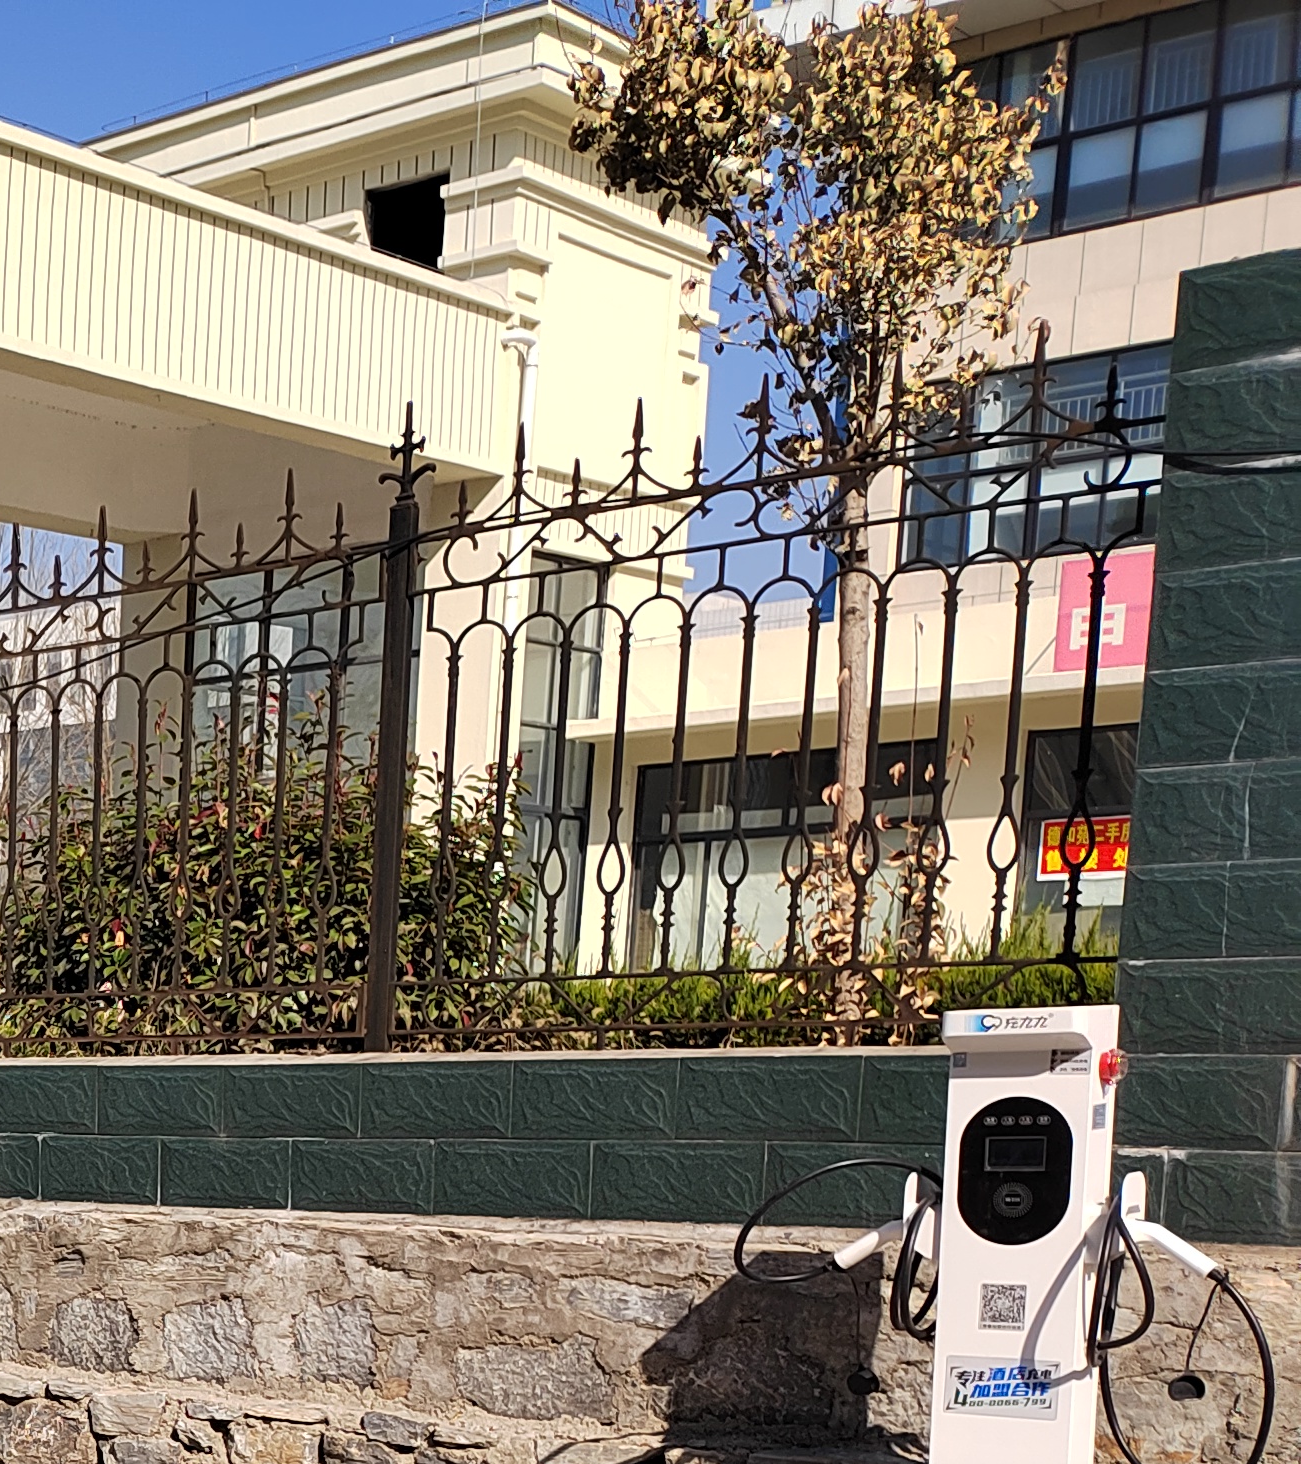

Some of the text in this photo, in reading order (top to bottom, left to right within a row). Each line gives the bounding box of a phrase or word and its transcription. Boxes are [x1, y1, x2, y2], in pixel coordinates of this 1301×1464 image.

[954, 1366, 1052, 1389] 专注酒店充电
[953, 1386, 1047, 1407] 400-0066-799
[969, 1381, 1052, 1398] 加盟合作
